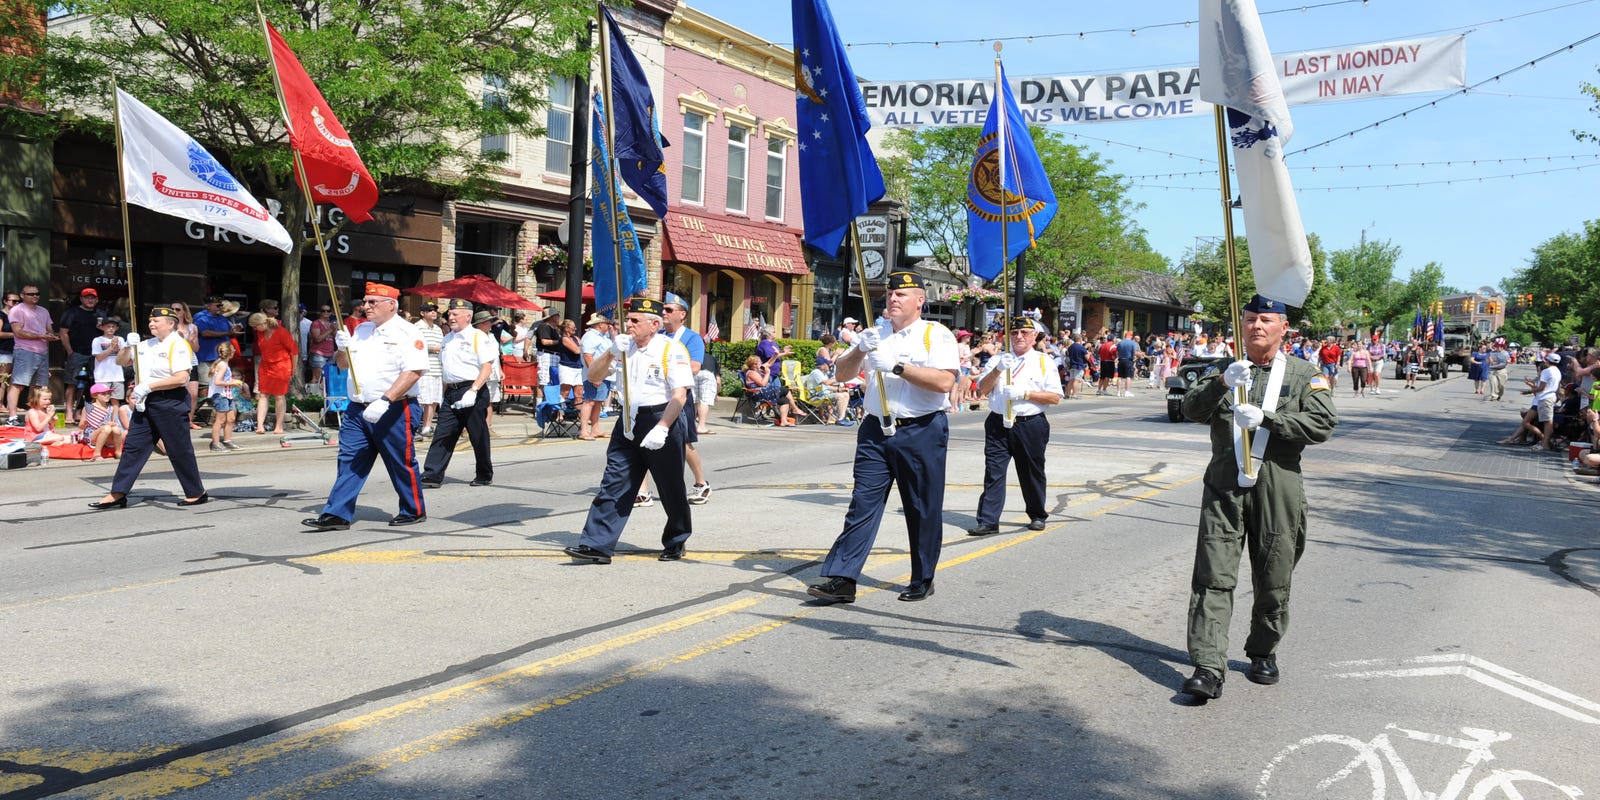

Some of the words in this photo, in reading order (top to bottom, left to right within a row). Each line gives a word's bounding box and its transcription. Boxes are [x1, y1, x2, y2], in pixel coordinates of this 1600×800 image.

[1284, 55, 1331, 77] LAST
[1337, 44, 1421, 71] MONDAY
[863, 82, 997, 108] EMORIA
[1020, 78, 1096, 105] DAY
[1105, 68, 1200, 101] PARA
[1319, 80, 1336, 97] IN
[1343, 74, 1384, 95] MAY
[884, 111, 924, 125] ALL
[930, 108, 1054, 125] VETENS
[1060, 99, 1193, 122] WELCOME
[161, 187, 199, 198] UNITED
[202, 193, 240, 209] STATES
[204, 204, 229, 217] 1775
[679, 215, 707, 233] THE
[712, 232, 768, 253] VILLAGE
[81, 258, 124, 268] COFFEE
[747, 253, 794, 271] FLORIST
[72, 275, 90, 283] ICE
